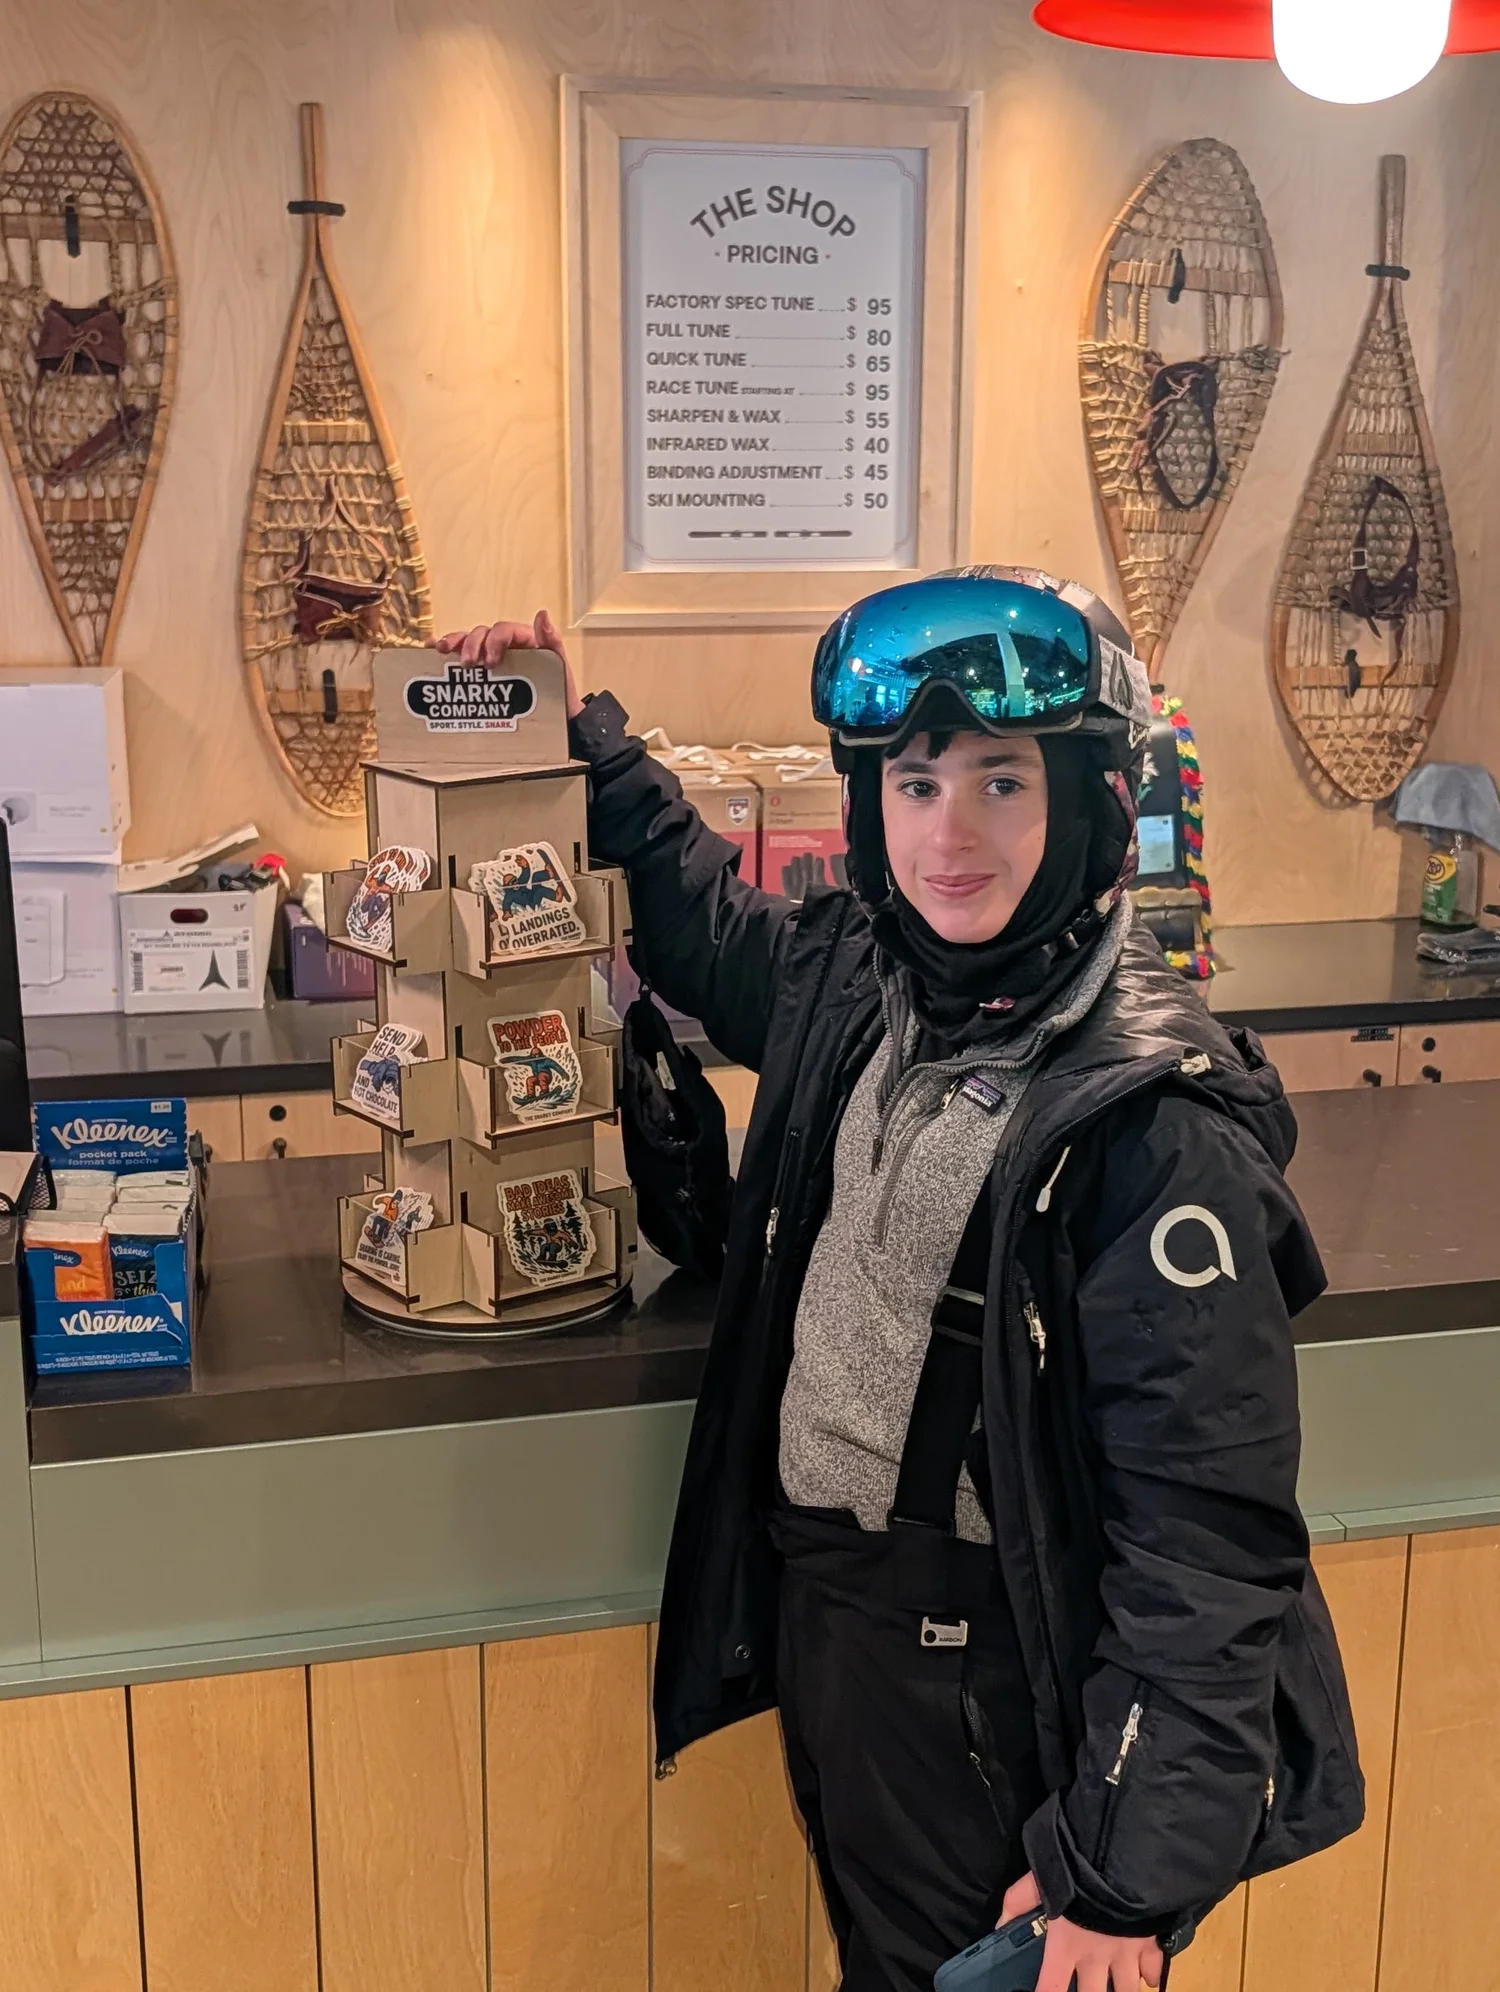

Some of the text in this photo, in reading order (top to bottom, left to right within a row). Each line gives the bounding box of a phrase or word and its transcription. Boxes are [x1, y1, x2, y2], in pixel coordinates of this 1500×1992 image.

[690, 185, 856, 239] THE SHOP
[727, 244, 819, 265] PRICING
[646, 294, 891, 315] FACTORY SPEC TUNE $ 95
[646, 323, 891, 346] FULL TUNE $ 80
[646, 352, 890, 372] QUICK TUNE $ 65
[646, 380, 691, 394] RACE
[695, 381, 739, 395] TUNE
[846, 382, 855, 396] $
[865, 384, 890, 401] 95
[646, 409, 890, 428] SHARPEN & WAX $ 55
[646, 437, 889, 454] INFRARED WAX $ 40
[646, 464, 888, 481] BINDING ADJUSTMENT $ 45
[647, 492, 888, 509] SKI MOUNTING $ 50
[452, 668, 485, 683] THE
[422, 683, 514, 704] SNARKY
[428, 704, 511, 718] COMPANY
[485, 721, 513, 729] SNARK.
[511, 907, 571, 936] LANDINGS
[512, 920, 580, 949] OVERRATED.
[379, 1026, 408, 1046] SEND
[492, 1014, 562, 1042] POWDER
[369, 1040, 396, 1057] HELP
[497, 1030, 568, 1054] TO THE PEOPLE
[356, 1074, 370, 1088] AND
[353, 1085, 366, 1098] HOT
[365, 1090, 398, 1113] CHOCOLATE
[50, 1117, 169, 1150] Kleenex
[68, 1157, 160, 1166] format de poche
[79, 1150, 148, 1159] pocket pack
[504, 1174, 571, 1202] BAD IDEAS
[506, 1188, 575, 1213] MAKE AWESOME
[521, 1201, 566, 1222] STORIES
[111, 1245, 149, 1258] Kleenex
[133, 1283, 157, 1297] this
